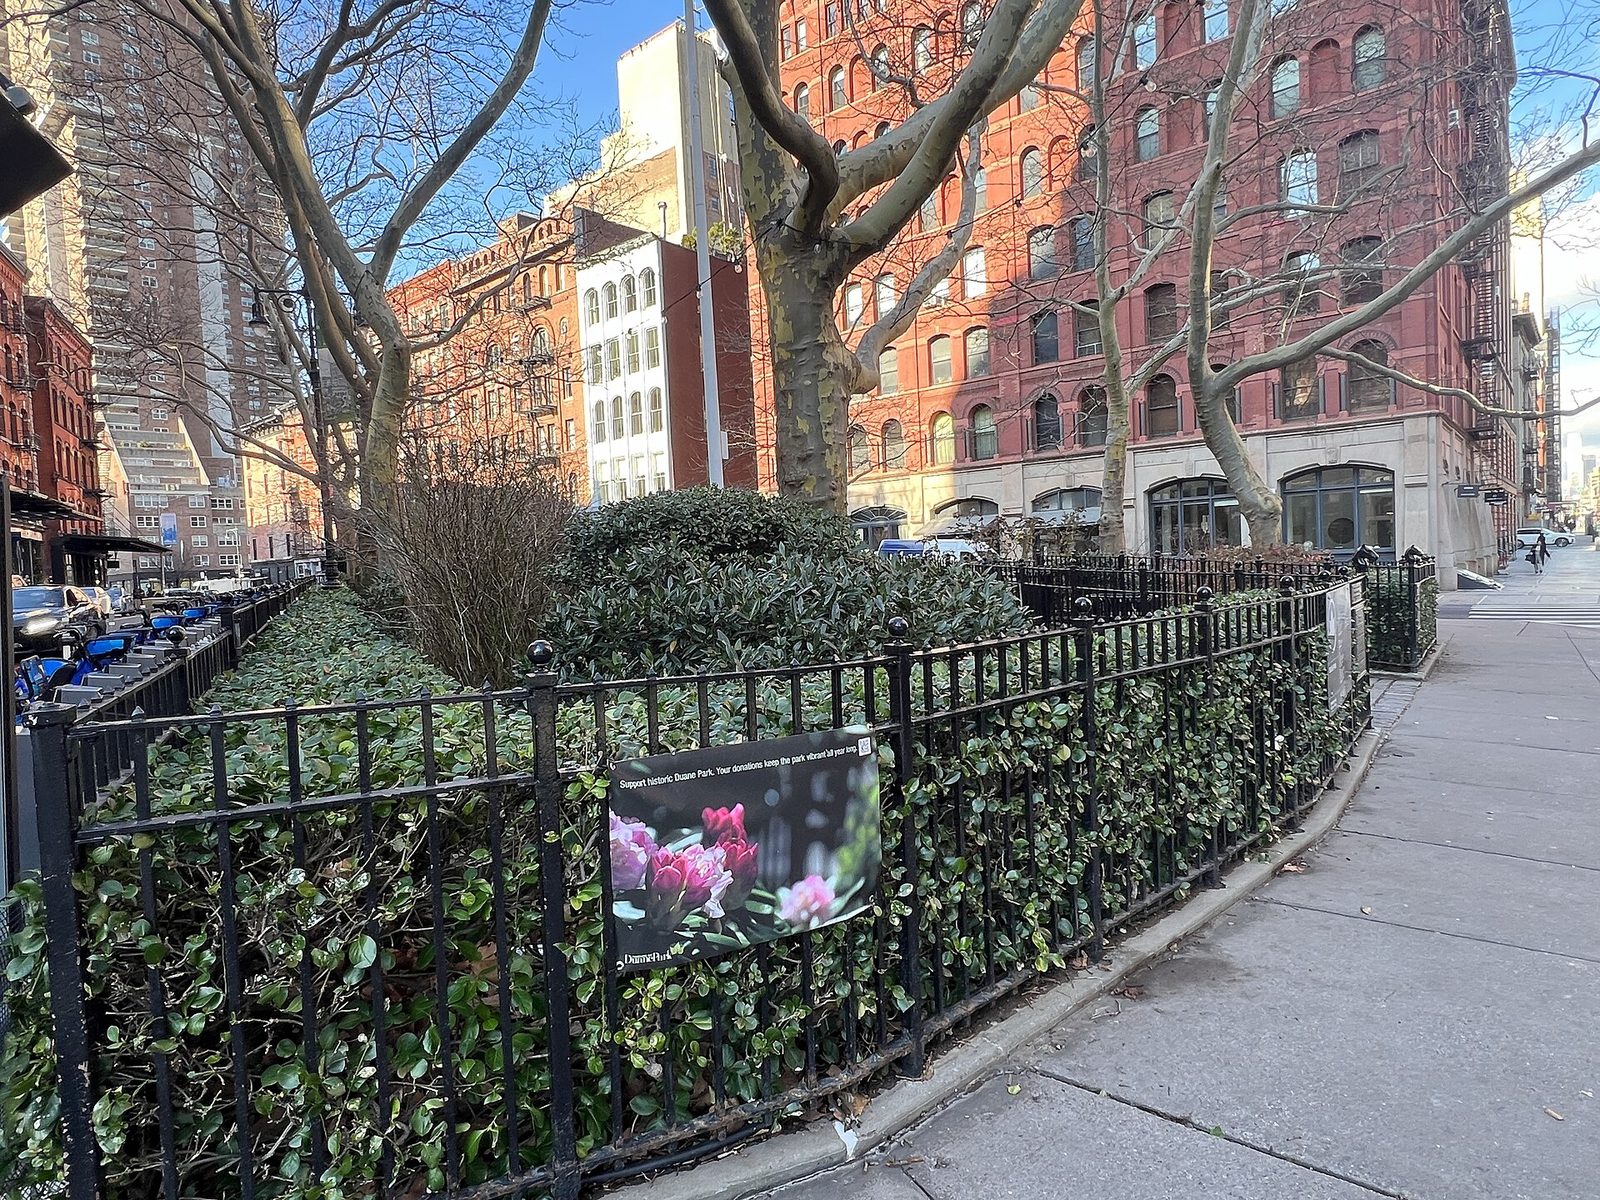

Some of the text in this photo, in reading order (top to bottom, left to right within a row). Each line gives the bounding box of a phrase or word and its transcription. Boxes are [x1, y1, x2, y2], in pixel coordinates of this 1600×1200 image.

[620, 779, 647, 789] Support
[647, 775, 674, 786] historic
[674, 772, 696, 781] Duane
[698, 769, 715, 778] Park.
[716, 766, 731, 775] Your
[732, 761, 763, 773] donations
[764, 758, 779, 768] keep
[780, 757, 791, 765] the
[791, 754, 806, 765] park
[806, 751, 826, 761] vibrant
[834, 747, 845, 757] year
